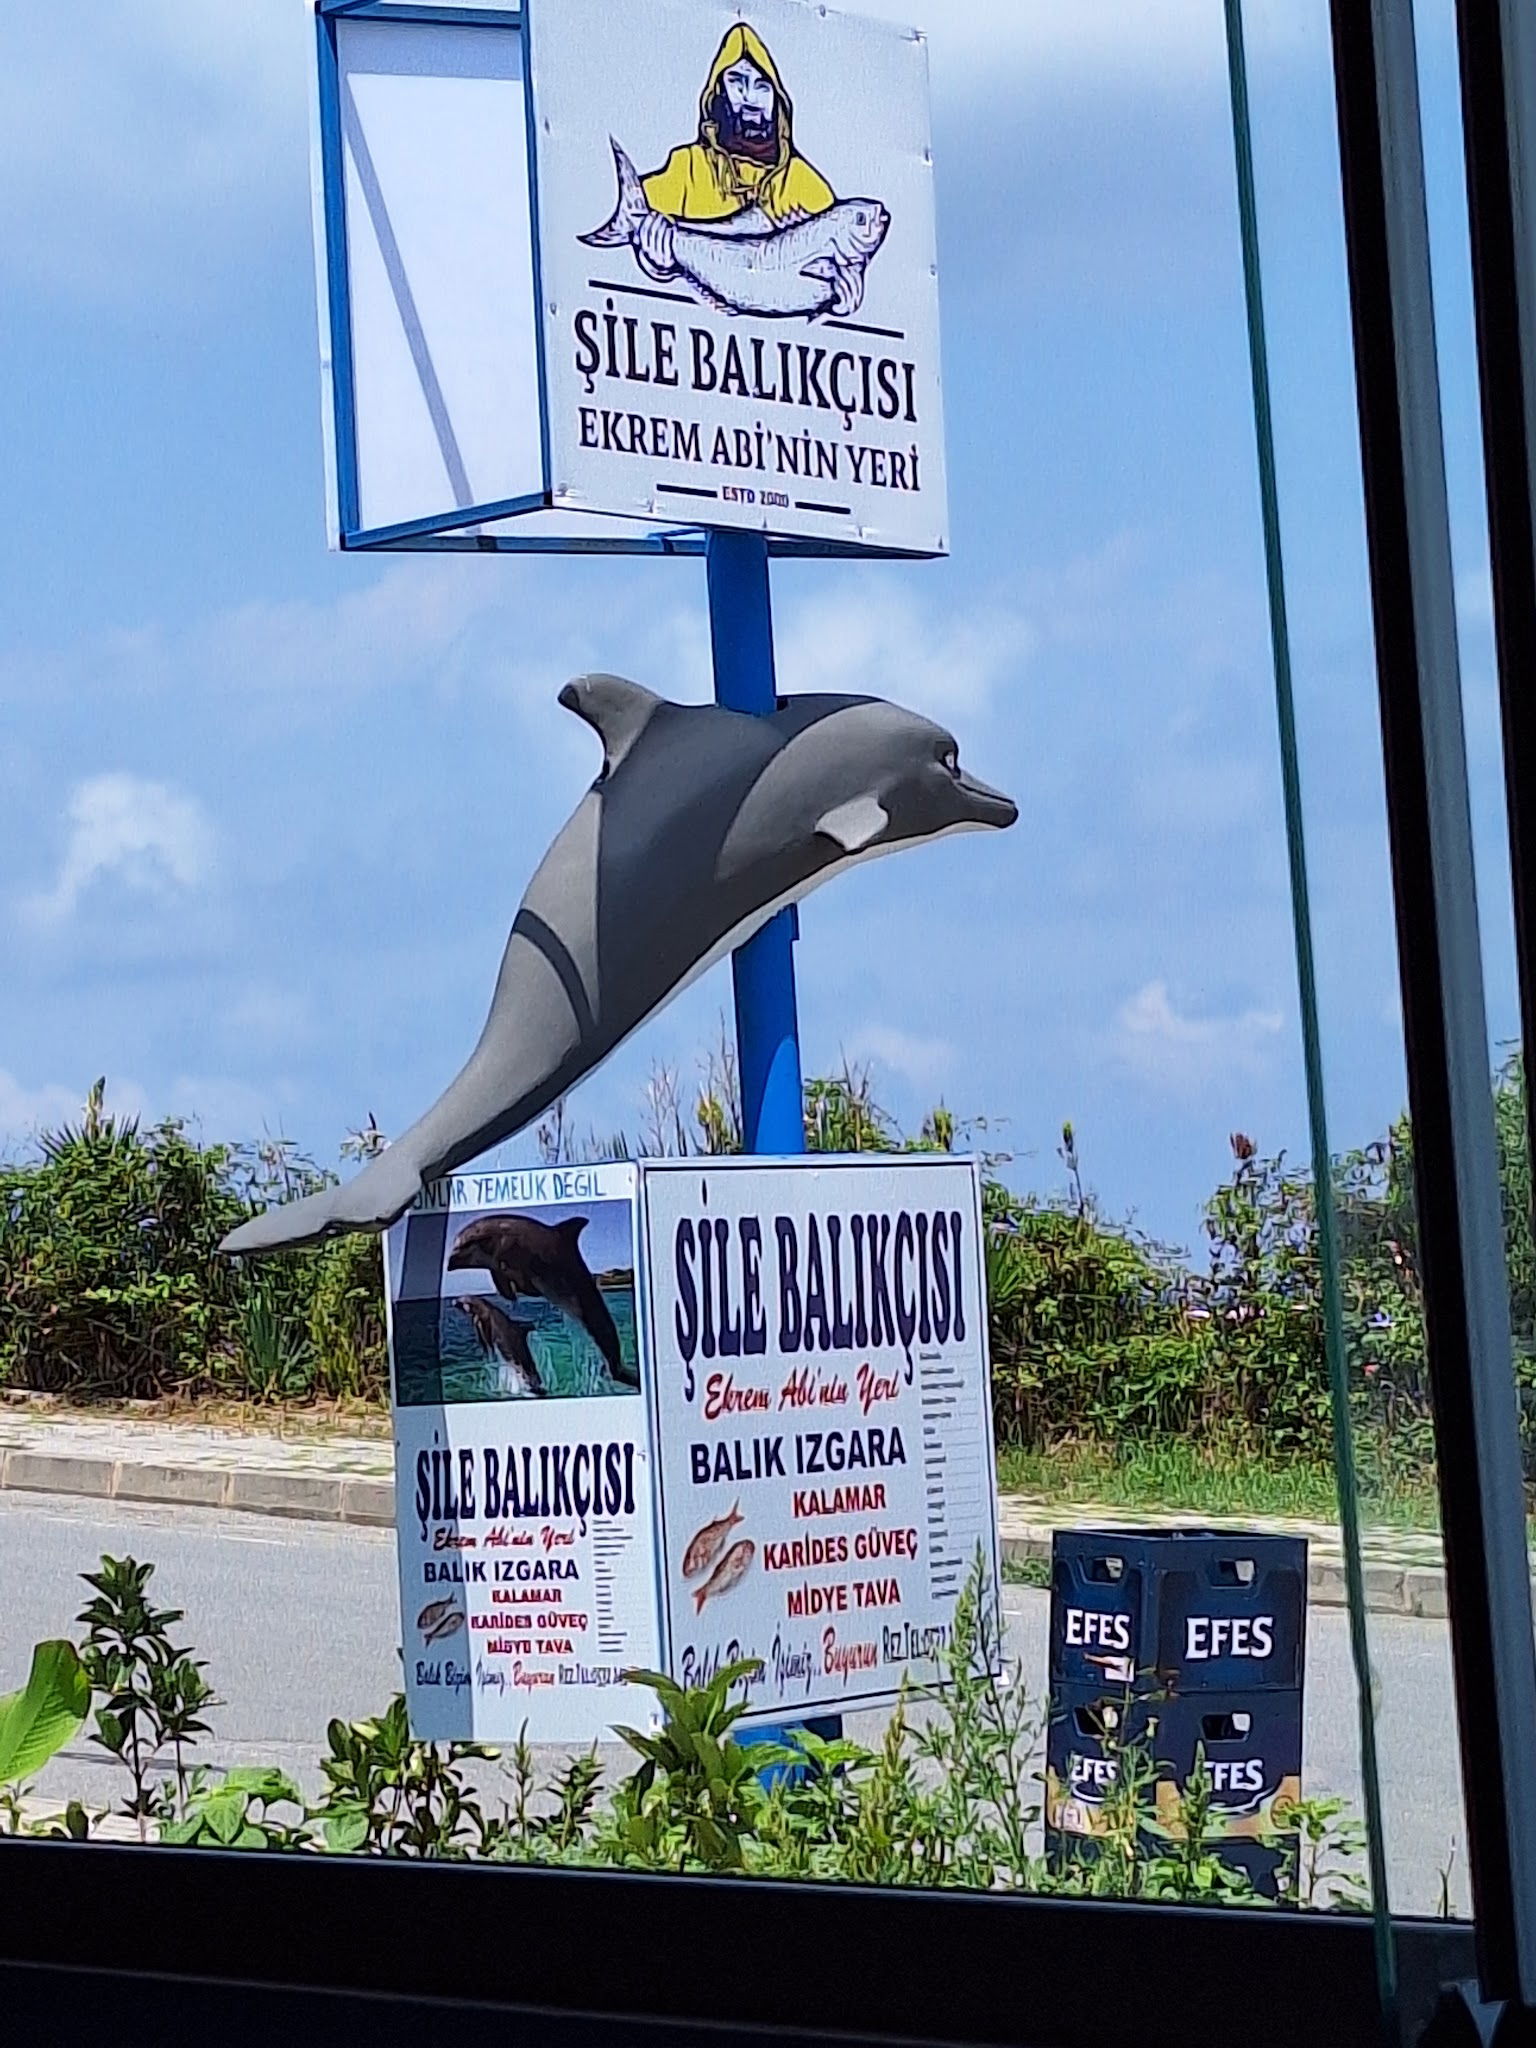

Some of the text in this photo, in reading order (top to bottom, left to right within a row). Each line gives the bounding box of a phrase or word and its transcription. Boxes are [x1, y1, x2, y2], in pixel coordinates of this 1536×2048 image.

[574, 298, 917, 431] ŞİLE BALIKÇISI
[579, 407, 921, 491] EKREM ABİ'NİN YERİ
[722, 486, 755, 504] ESTD
[675, 1178, 966, 1402] ŞİLE BALIKÇISI
[690, 1426, 906, 1484] BALIK IZGARA
[416, 1430, 636, 1541] ŞİLE BALIKÇISI
[793, 1484, 887, 1518] KALAMAR
[424, 1559, 579, 1582] BALIK IZGARA
[764, 1526, 918, 1571] KARİDES GÜVEÇ
[787, 1578, 902, 1617] MİDYE TAVA
[1065, 1608, 1274, 1660] EFES EFES
